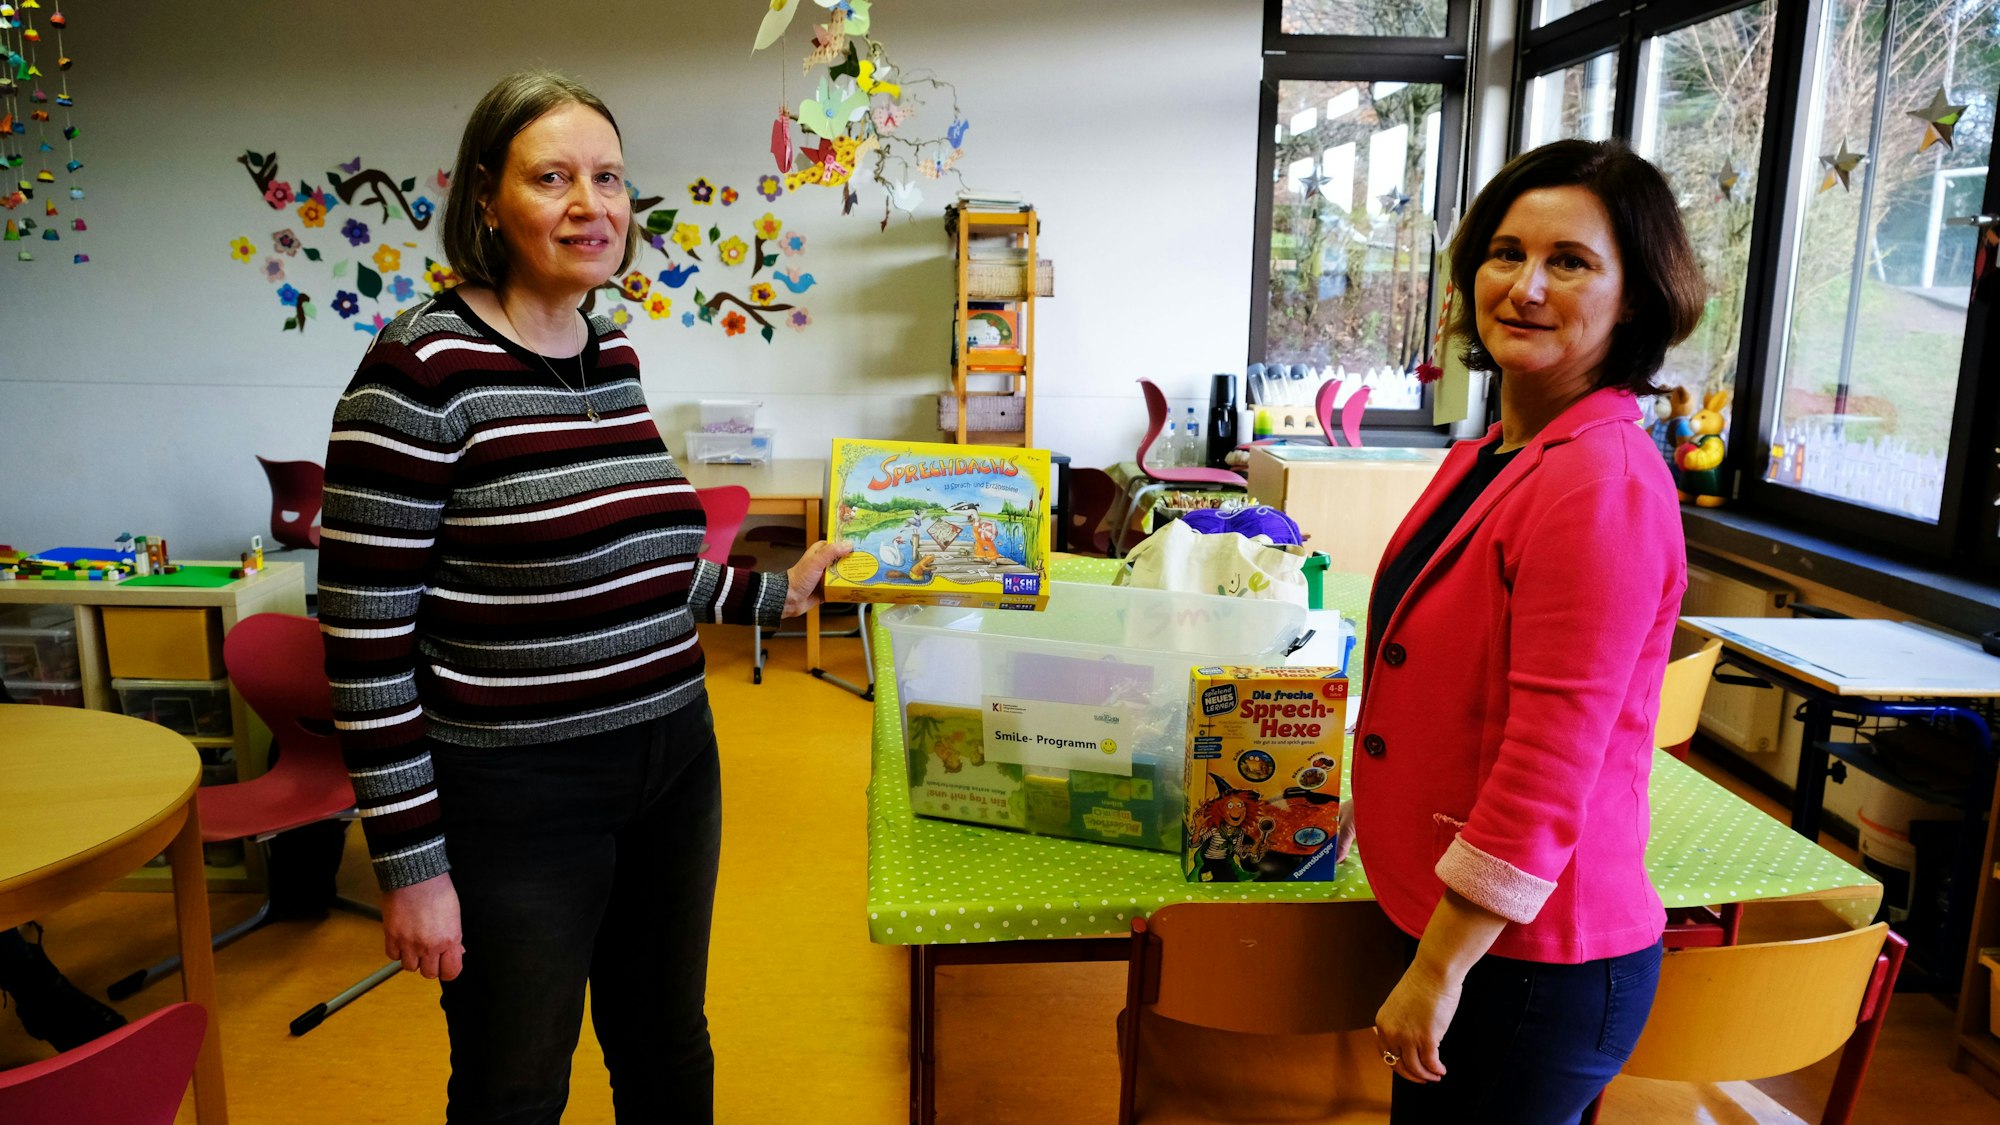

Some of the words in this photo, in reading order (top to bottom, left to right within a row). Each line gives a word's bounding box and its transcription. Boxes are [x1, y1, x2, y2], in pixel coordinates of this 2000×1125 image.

[867, 453, 1019, 490] SPRECHDACHS
[1204, 693, 1234, 706] NEUES
[1252, 690, 1271, 700] Die
[1274, 690, 1314, 701] freche
[1206, 700, 1235, 712] LERNEN
[1240, 700, 1334, 723] Sprech-
[1260, 719, 1321, 738] Hexe
[994, 730, 1033, 744] SmiLe-
[1036, 734, 1097, 750] Programm
[969, 793, 988, 805] Tag
[1292, 842, 1334, 879] Ravensburger
